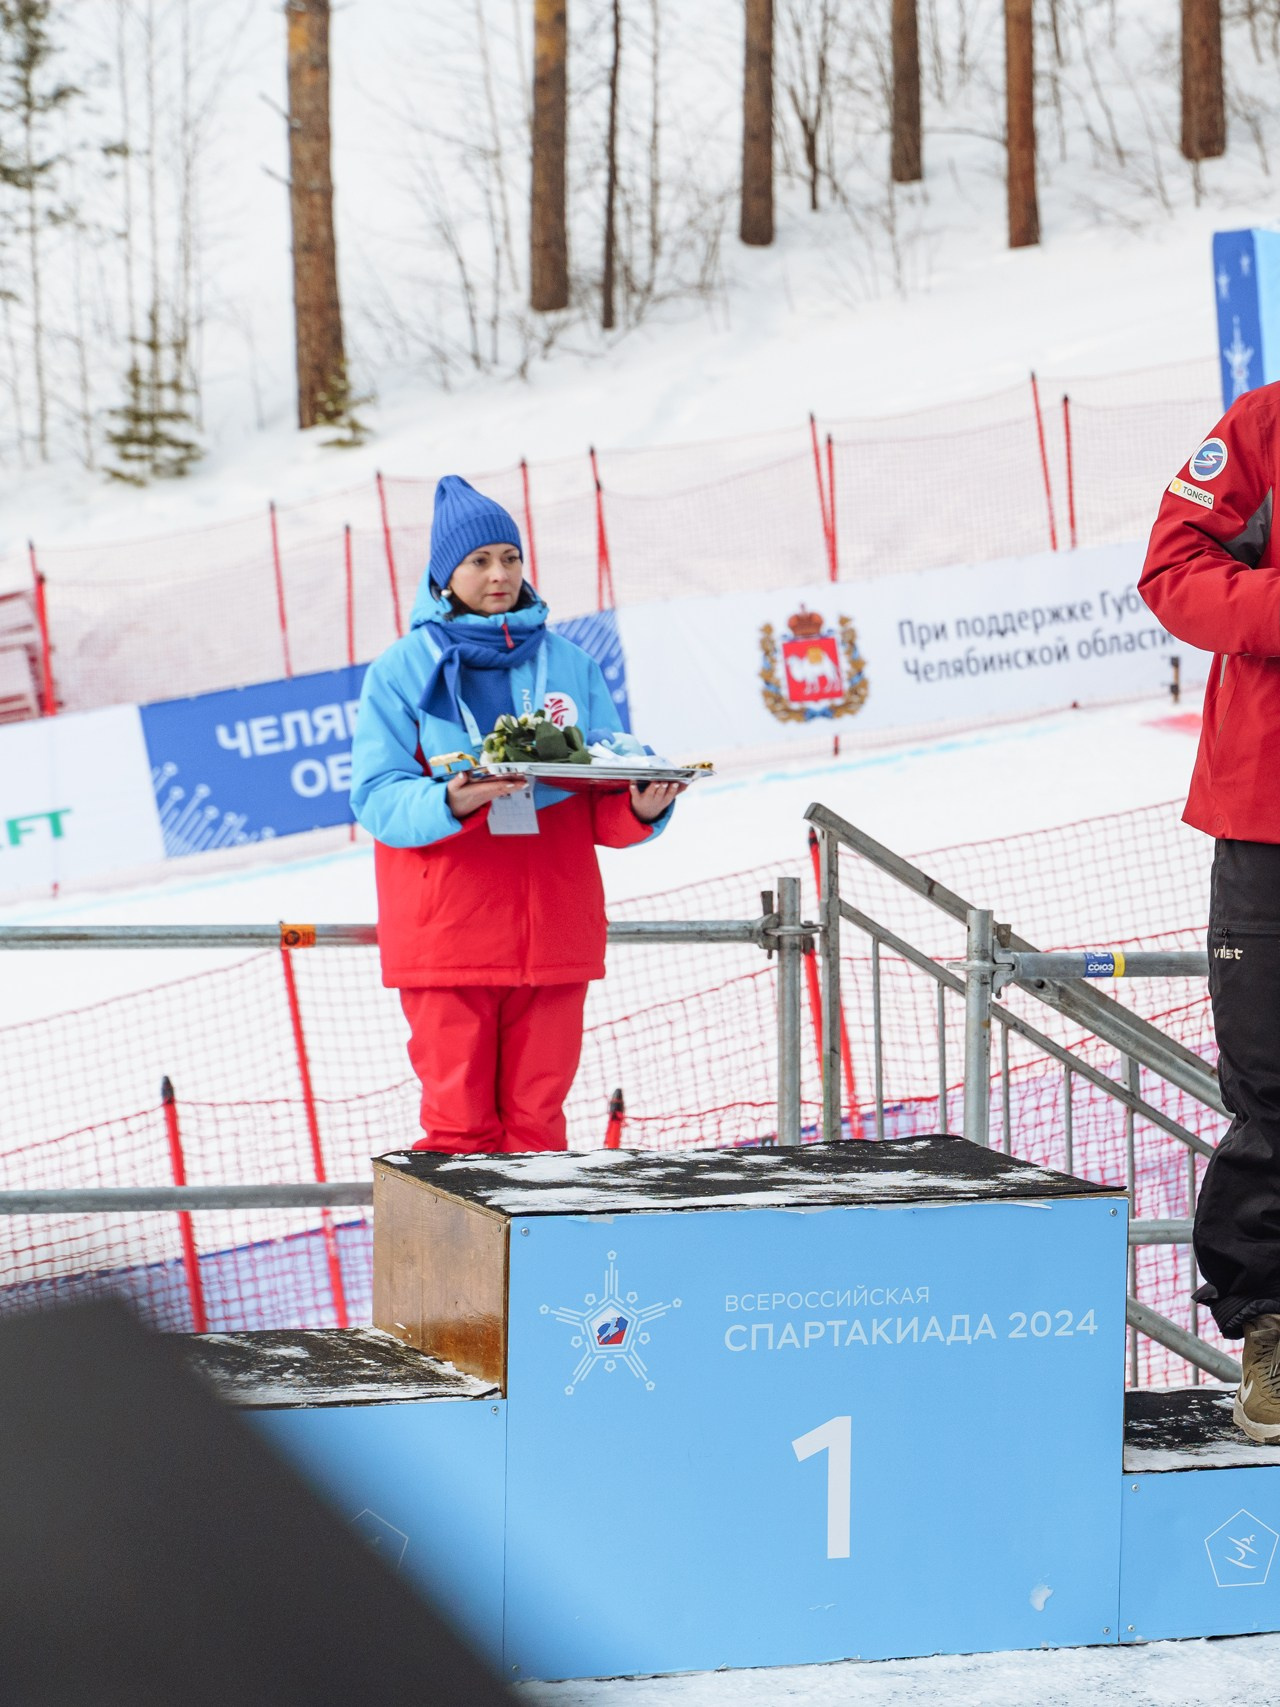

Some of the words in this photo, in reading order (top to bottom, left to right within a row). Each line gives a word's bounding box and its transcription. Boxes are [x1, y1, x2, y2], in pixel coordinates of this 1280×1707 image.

[898, 619, 948, 651] При
[955, 599, 1093, 638] поддержке
[1100, 584, 1147, 624] Губ
[903, 636, 1070, 683] Челябинской
[1077, 627, 1175, 660] области
[0, 808, 73, 851] FT
[724, 1285, 931, 1313] ВСЕРОССИЙСКАЯ
[723, 1313, 997, 1353] СПАРТАКИАДА
[1007, 1308, 1099, 1339] 2024
[791, 1415, 852, 1560] 1
